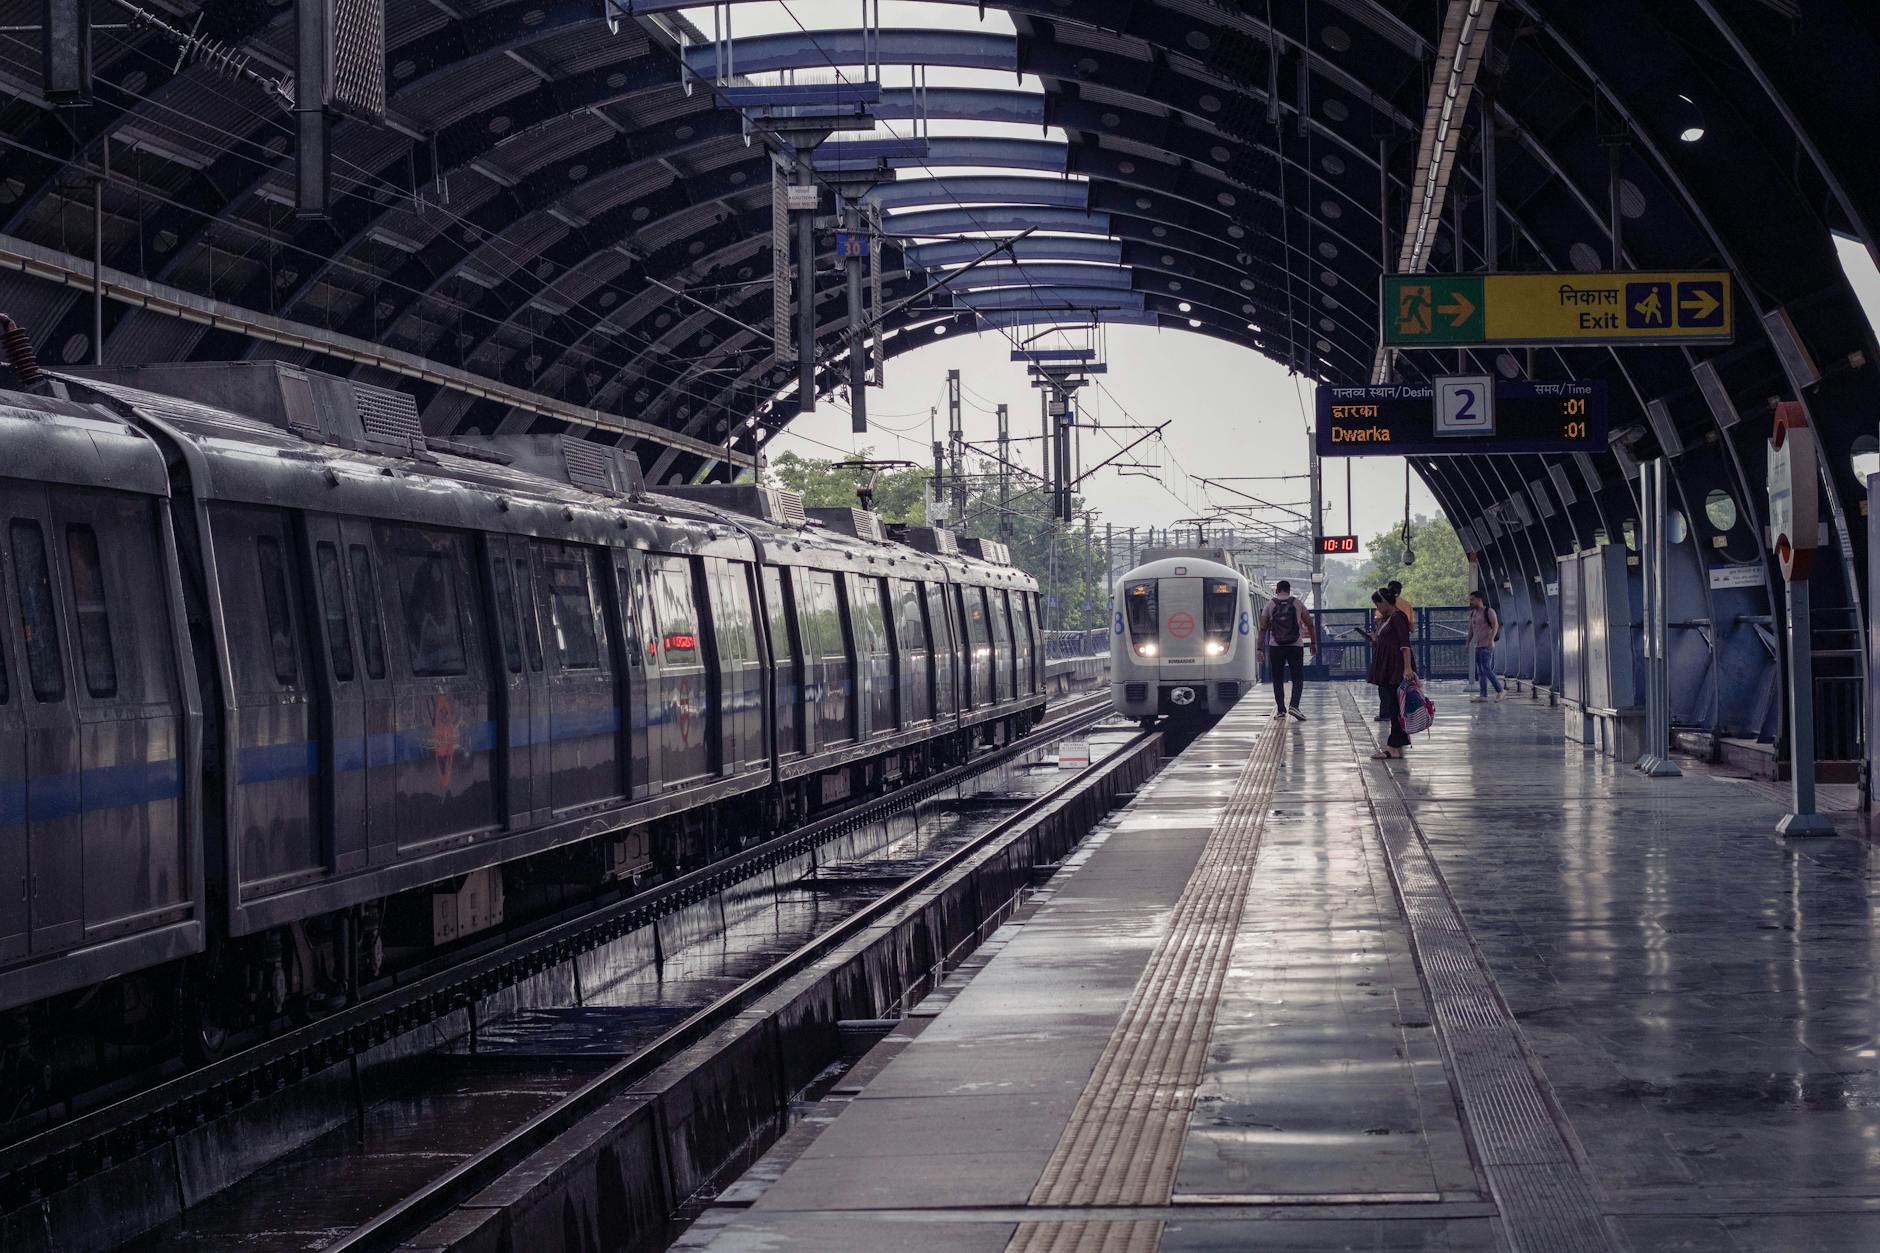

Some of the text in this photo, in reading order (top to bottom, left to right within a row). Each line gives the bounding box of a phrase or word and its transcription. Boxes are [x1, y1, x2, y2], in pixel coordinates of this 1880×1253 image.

[1558, 284, 1620, 306] निकास
[1579, 312, 1619, 329] Exit
[1332, 387, 1366, 399] गन्तव्य
[1331, 405, 1378, 418] द्वारका
[1453, 388, 1477, 421] 2
[1331, 426, 1390, 442] Dwarka
